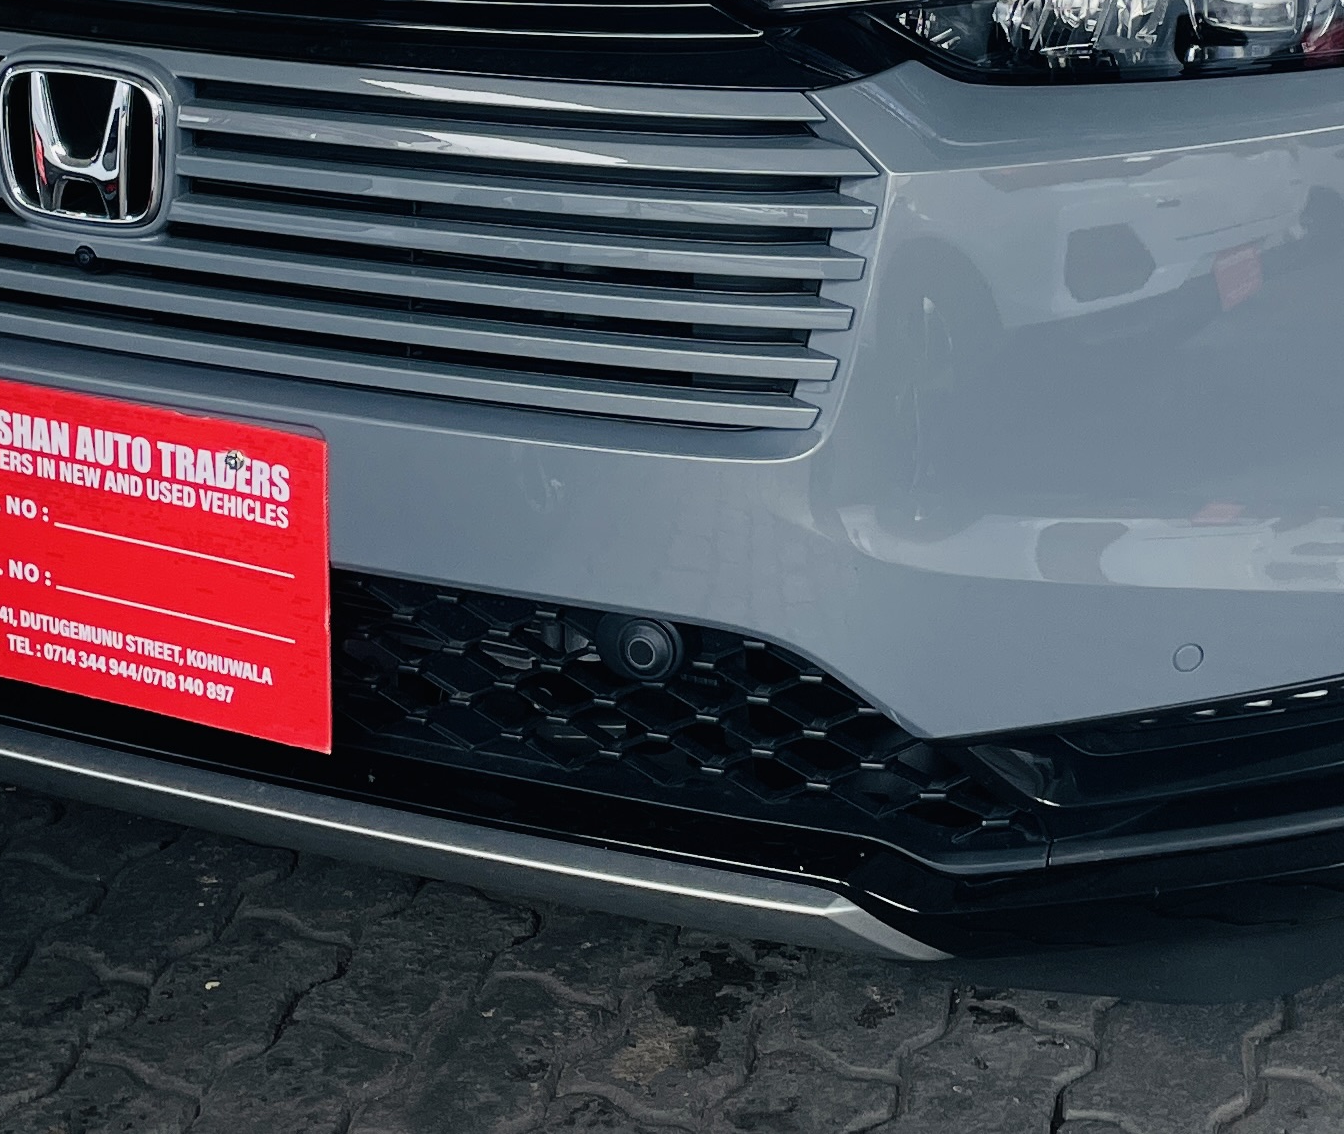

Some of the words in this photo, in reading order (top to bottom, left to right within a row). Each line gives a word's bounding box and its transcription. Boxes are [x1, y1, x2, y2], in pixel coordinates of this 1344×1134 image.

[36, 456, 56, 480] IN
[59, 460, 102, 489] NEW
[104, 470, 143, 497] AND
[146, 478, 196, 508] USED
[199, 488, 289, 529] VEHICLES
[75, 425, 152, 474] AUTO
[156, 441, 291, 502] TRADERS
[6, 495, 38, 519] NO
[8, 559, 40, 583] NO
[6, 633, 34, 656] TEL
[43, 643, 77, 665] 0714
[78, 651, 107, 673] 344
[108, 658, 176, 690] 944/0718
[178, 674, 204, 696] 140
[206, 682, 235, 704] 897
[19, 609, 124, 650] DUTUGEMUNU
[125, 634, 184, 666] STREET,
[186, 648, 273, 686] KOHUWALA
